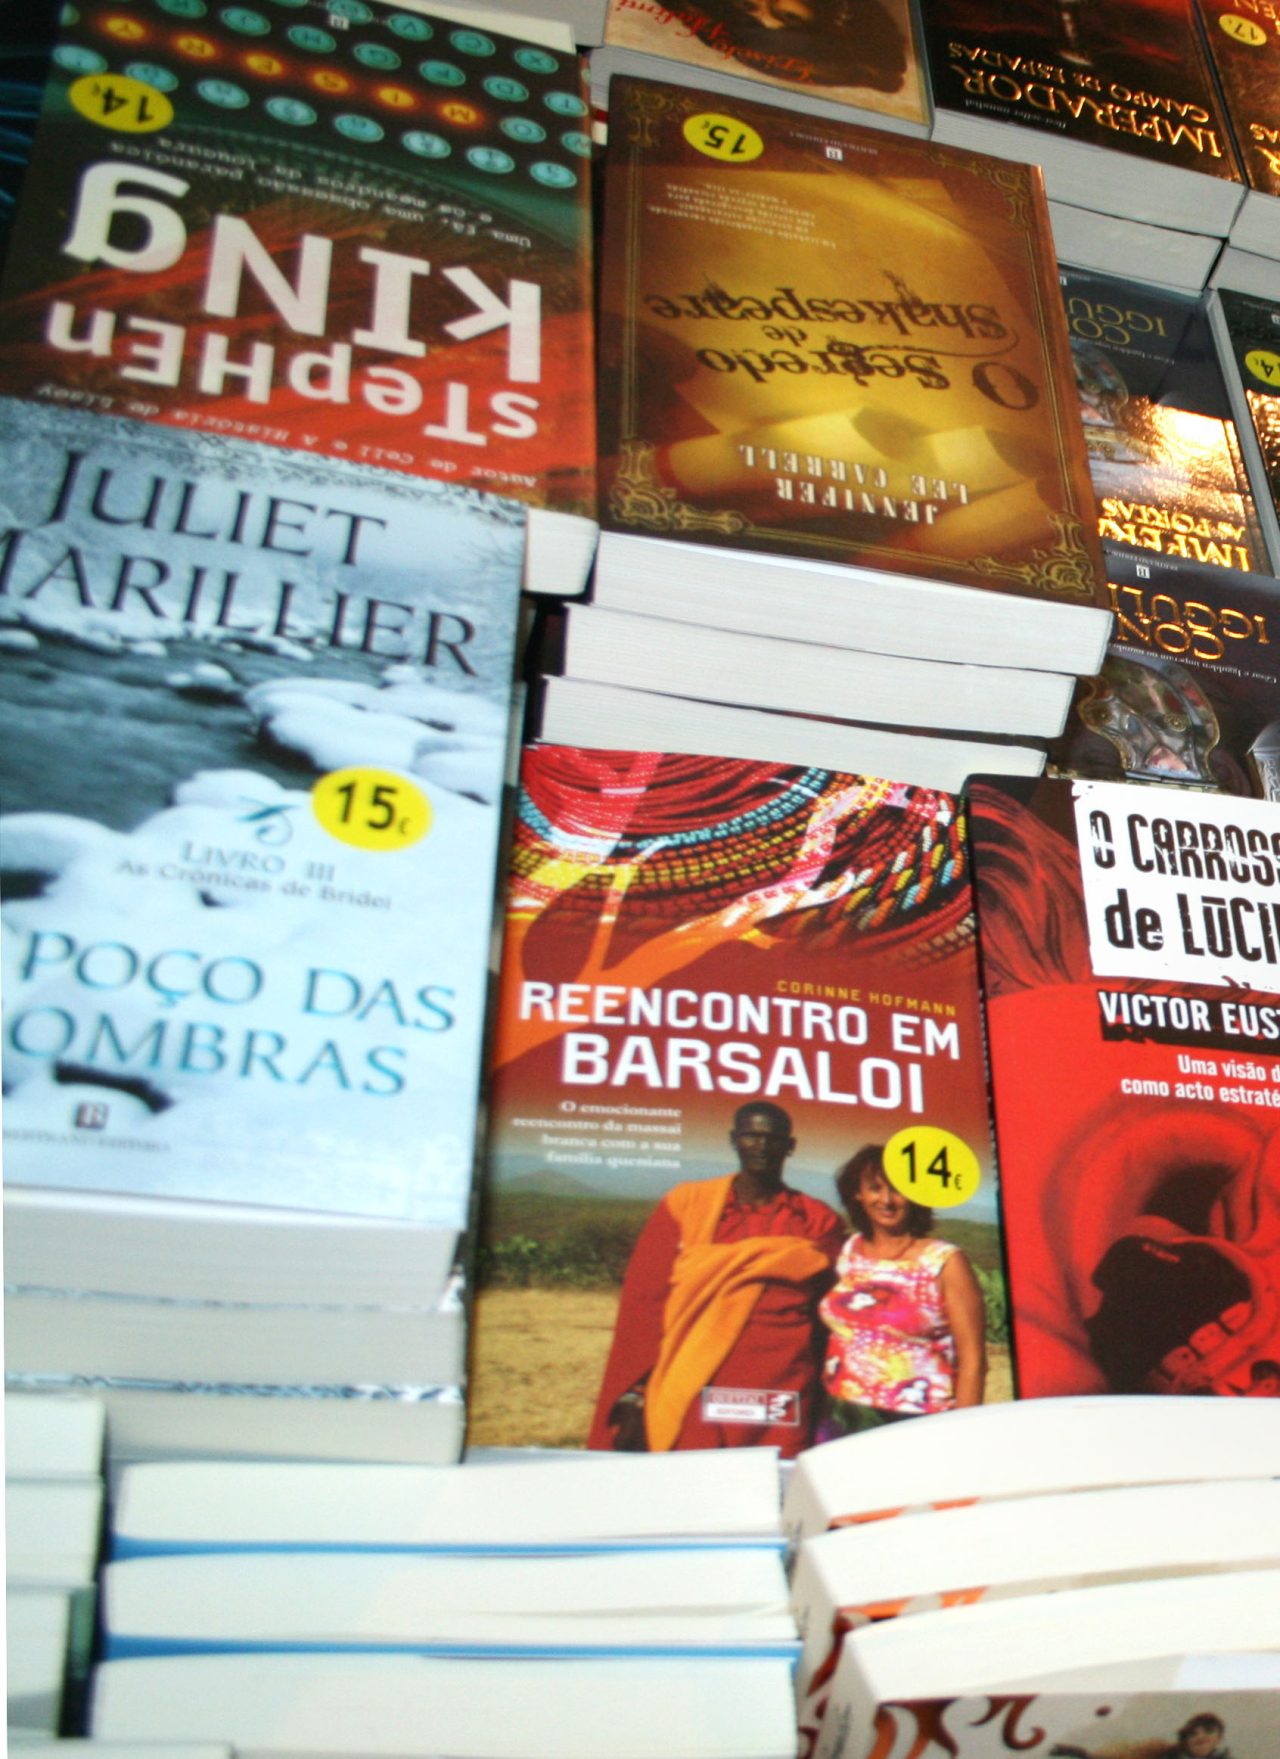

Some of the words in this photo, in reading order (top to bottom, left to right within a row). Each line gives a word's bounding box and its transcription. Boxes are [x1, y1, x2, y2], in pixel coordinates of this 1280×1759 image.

[951, 64, 1222, 158] IMPERADOR
[1110, 84, 1209, 123] CAMPO
[639, 271, 1006, 342] Shakespeare
[695, 335, 951, 392] Segredo
[972, 361, 1039, 411] O
[740, 445, 889, 487] CARRELL
[910, 475, 969, 504] LEE
[33, 449, 388, 566] JULIET
[775, 477, 938, 525] JENNIFER
[181, 841, 287, 875] LIVRO
[306, 860, 335, 882] III
[1088, 809, 1117, 870] O
[116, 859, 150, 878] As
[281, 880, 313, 898] de
[1104, 888, 1164, 952] de
[21, 930, 265, 1008] POÇO
[303, 967, 456, 1035] DAS
[777, 979, 862, 1003] CORINNE
[869, 991, 957, 1017] HOFMANN
[519, 981, 869, 1045] REENCONTRO
[891, 1015, 961, 1060] EM
[1098, 990, 1212, 1032] VICTOR
[8, 1005, 408, 1097] OMBRAS
[562, 1033, 924, 1114] BARSALOI
[1176, 1054, 1218, 1079] Uma
[1222, 1057, 1268, 1083] visão
[560, 1101, 577, 1113] O
[1120, 1077, 1171, 1099] como
[1175, 1080, 1215, 1102] acto
